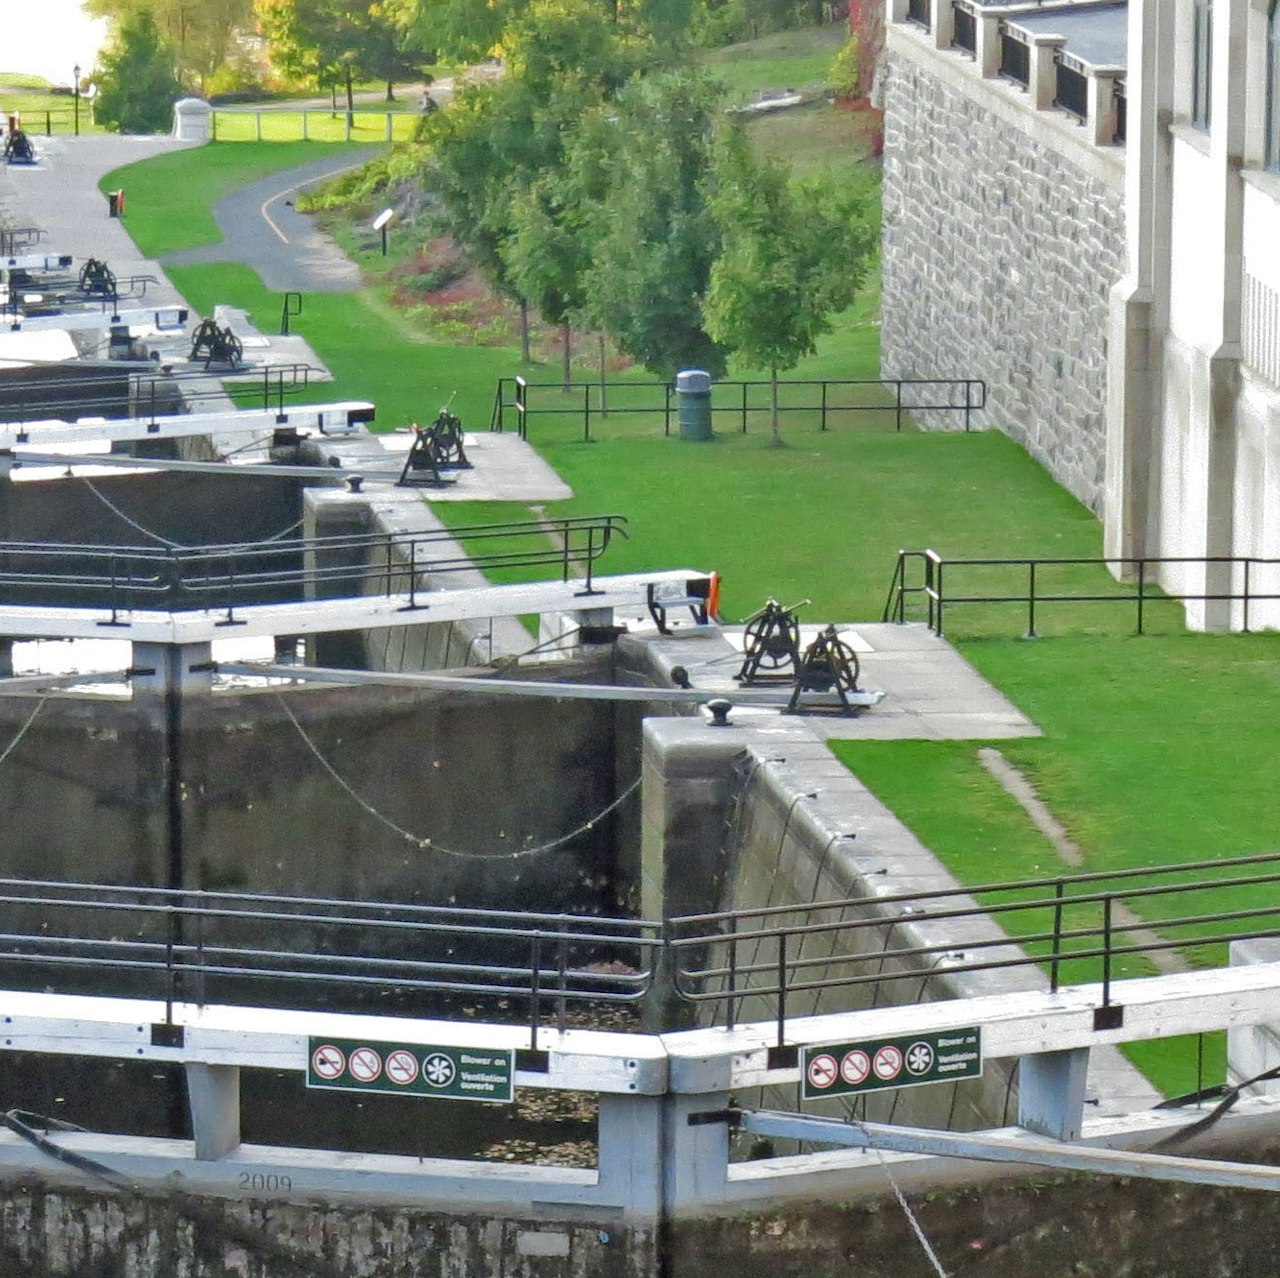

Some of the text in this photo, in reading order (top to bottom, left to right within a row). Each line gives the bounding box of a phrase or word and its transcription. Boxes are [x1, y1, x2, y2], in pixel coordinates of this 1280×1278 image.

[461, 1055, 491, 1065] Blower
[938, 1053, 977, 1063] Ventilation
[461, 1072, 507, 1083] Ventilation
[461, 1082, 494, 1091] ouverte
[239, 1172, 291, 1192] 2009
